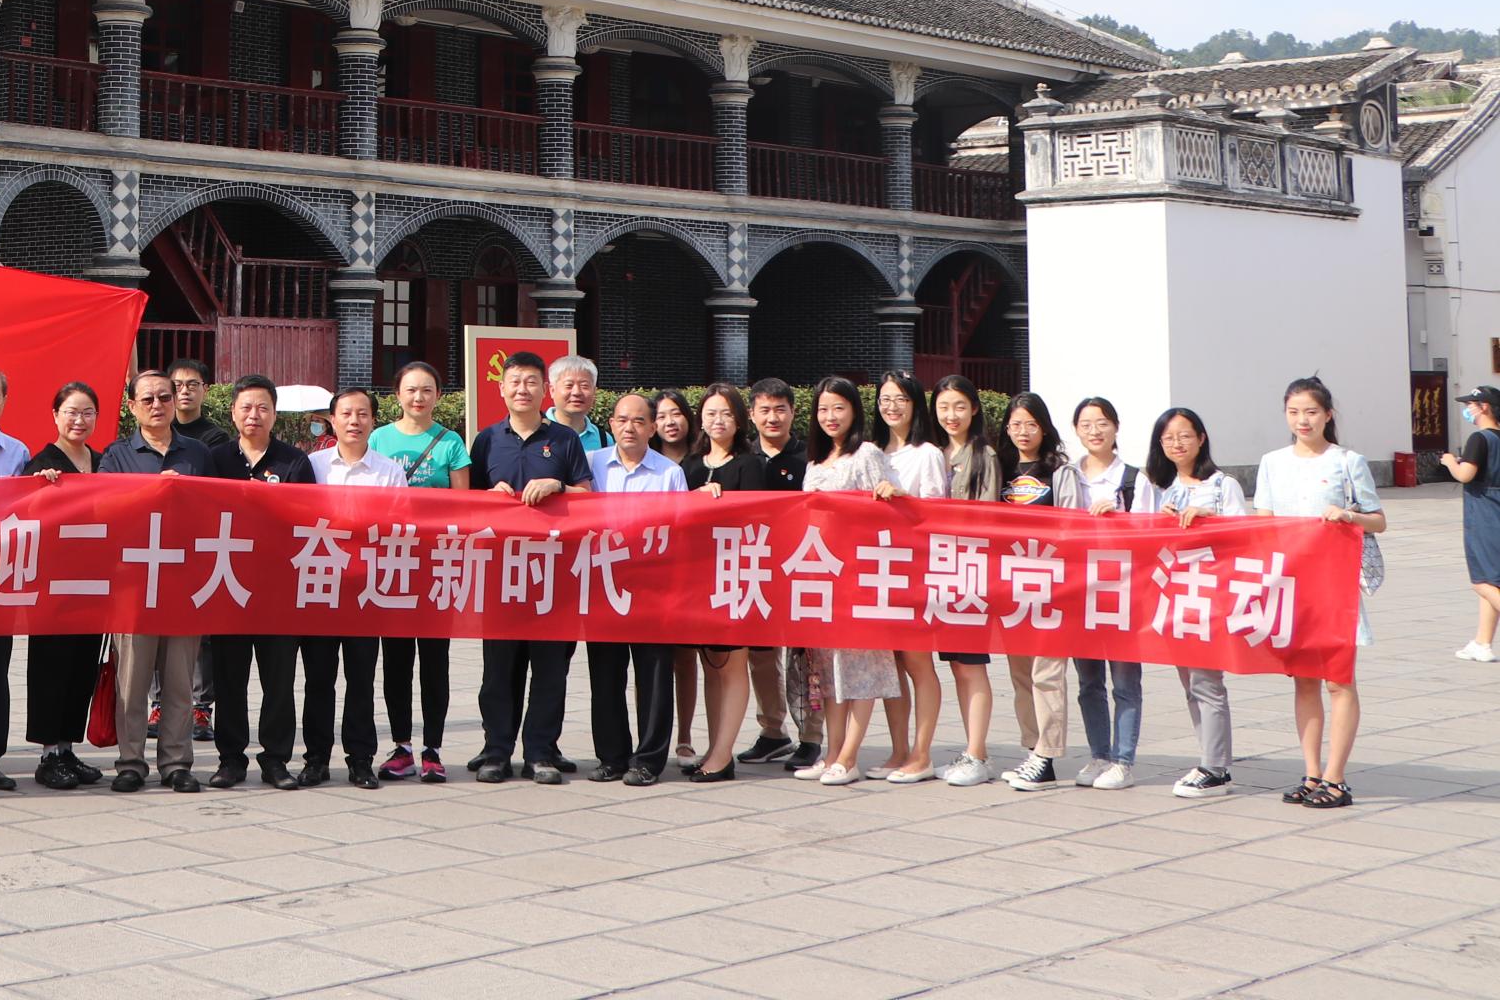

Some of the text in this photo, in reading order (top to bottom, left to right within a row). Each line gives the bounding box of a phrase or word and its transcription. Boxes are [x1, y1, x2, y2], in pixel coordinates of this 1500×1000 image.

[291, 518, 670, 615] 奋进新时代”
[711, 525, 1296, 648] 联合主题党日活动
